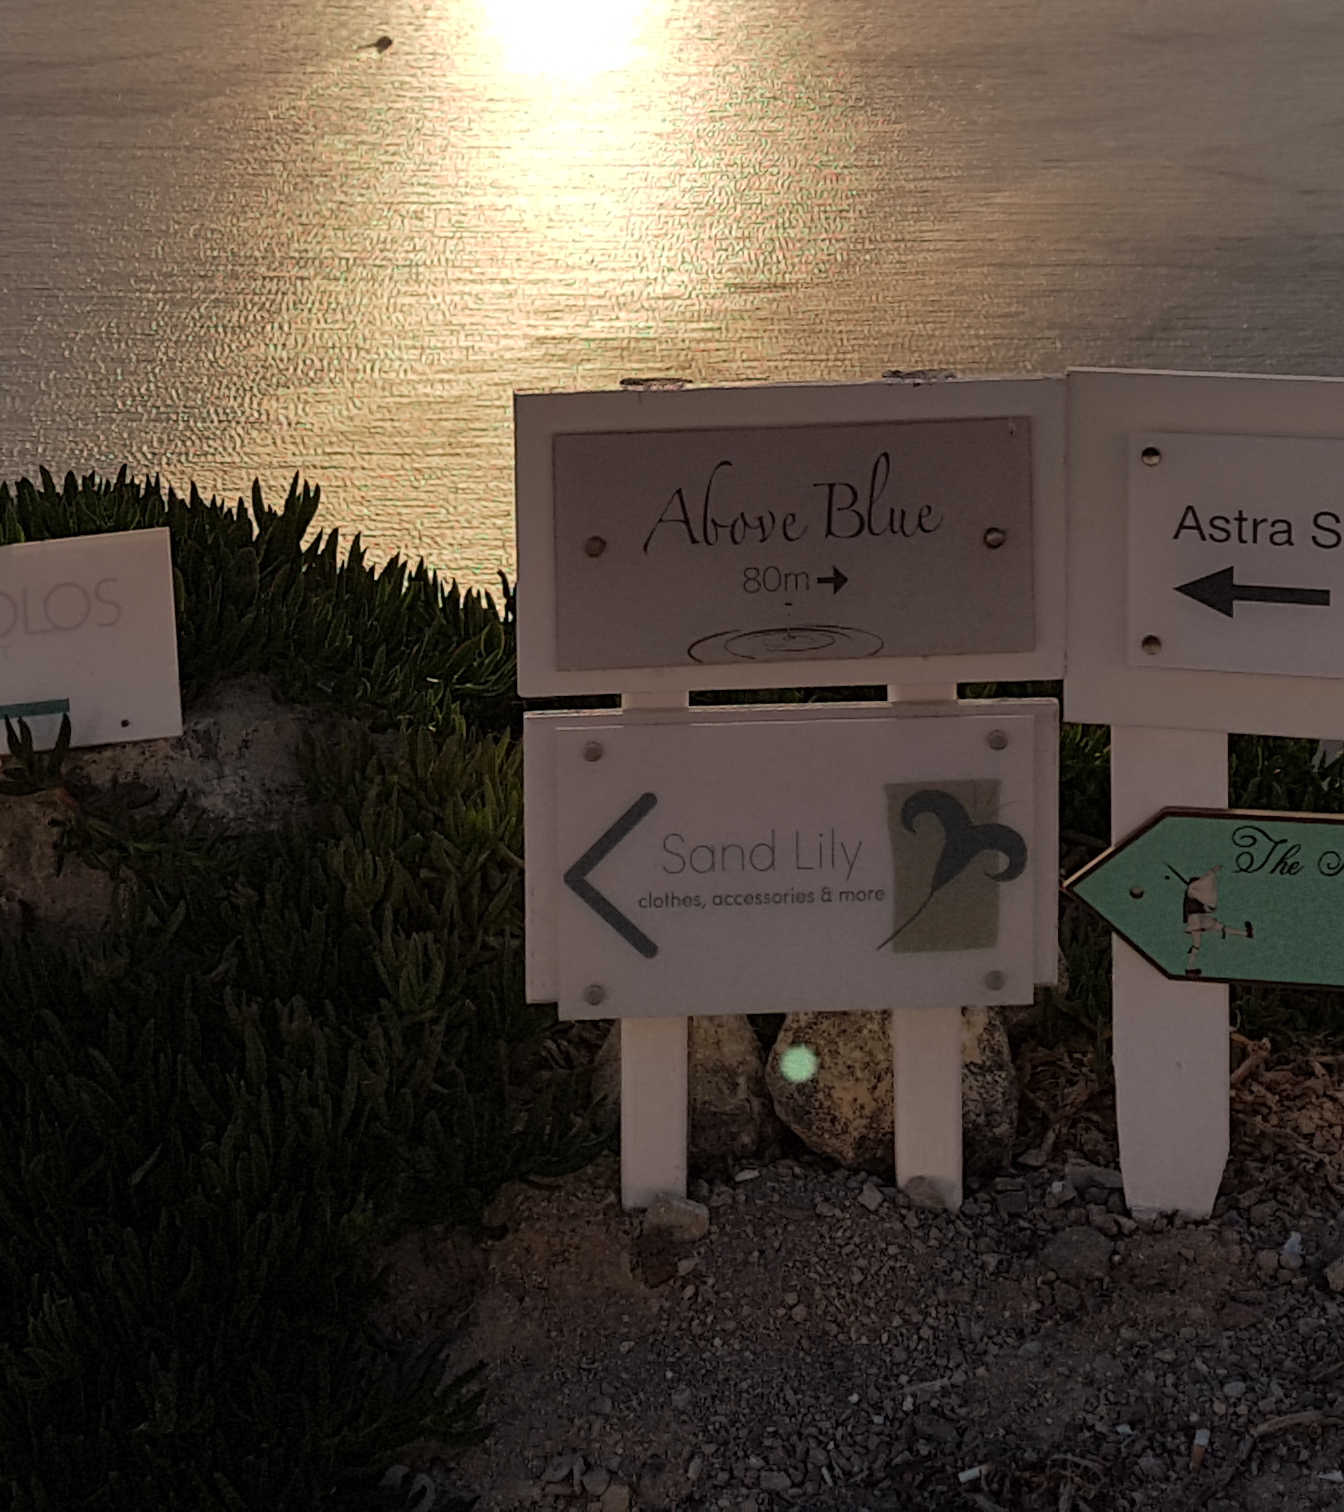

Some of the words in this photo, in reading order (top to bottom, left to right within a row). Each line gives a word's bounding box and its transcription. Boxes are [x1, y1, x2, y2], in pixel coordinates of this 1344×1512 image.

[642, 459, 808, 556] Above
[813, 451, 944, 540] Blue
[1172, 504, 1295, 549] Astra
[742, 565, 810, 594] 80m
[661, 828, 777, 875] Sand
[795, 827, 864, 881] Lily
[1231, 824, 1304, 876] The
[638, 891, 707, 910] clothes,
[711, 886, 816, 907] accessories
[820, 886, 833, 903] &
[838, 886, 886, 903] more
